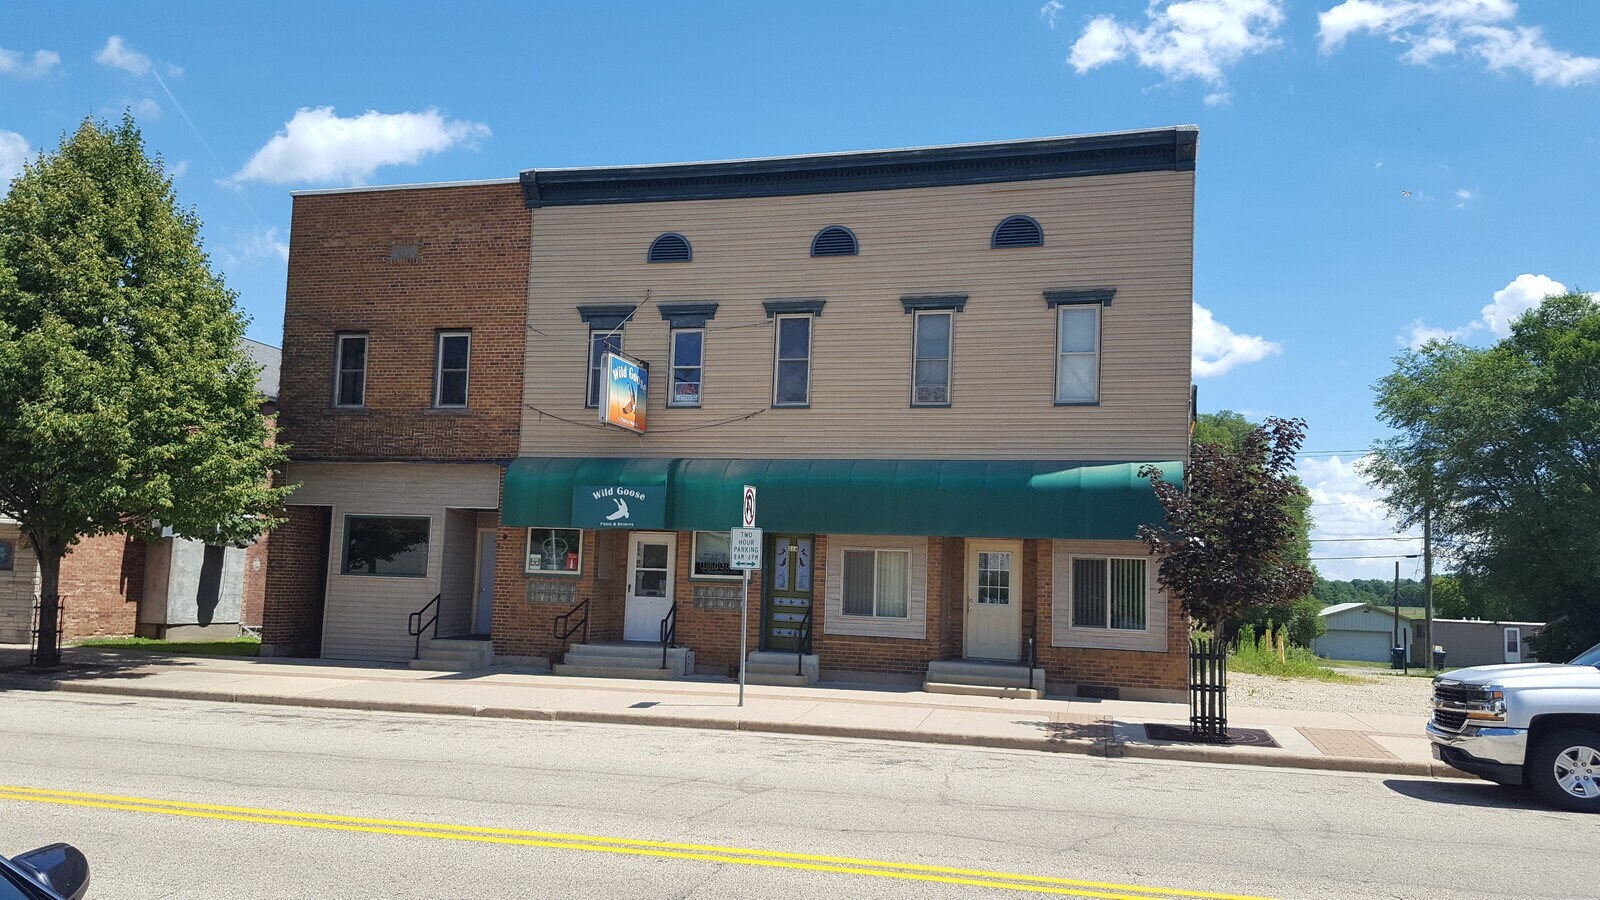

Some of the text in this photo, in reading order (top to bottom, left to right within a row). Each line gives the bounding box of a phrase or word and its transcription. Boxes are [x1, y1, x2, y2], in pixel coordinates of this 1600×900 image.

[612, 366, 646, 393] Wild Goose
[592, 486, 646, 501] Wild Goose
